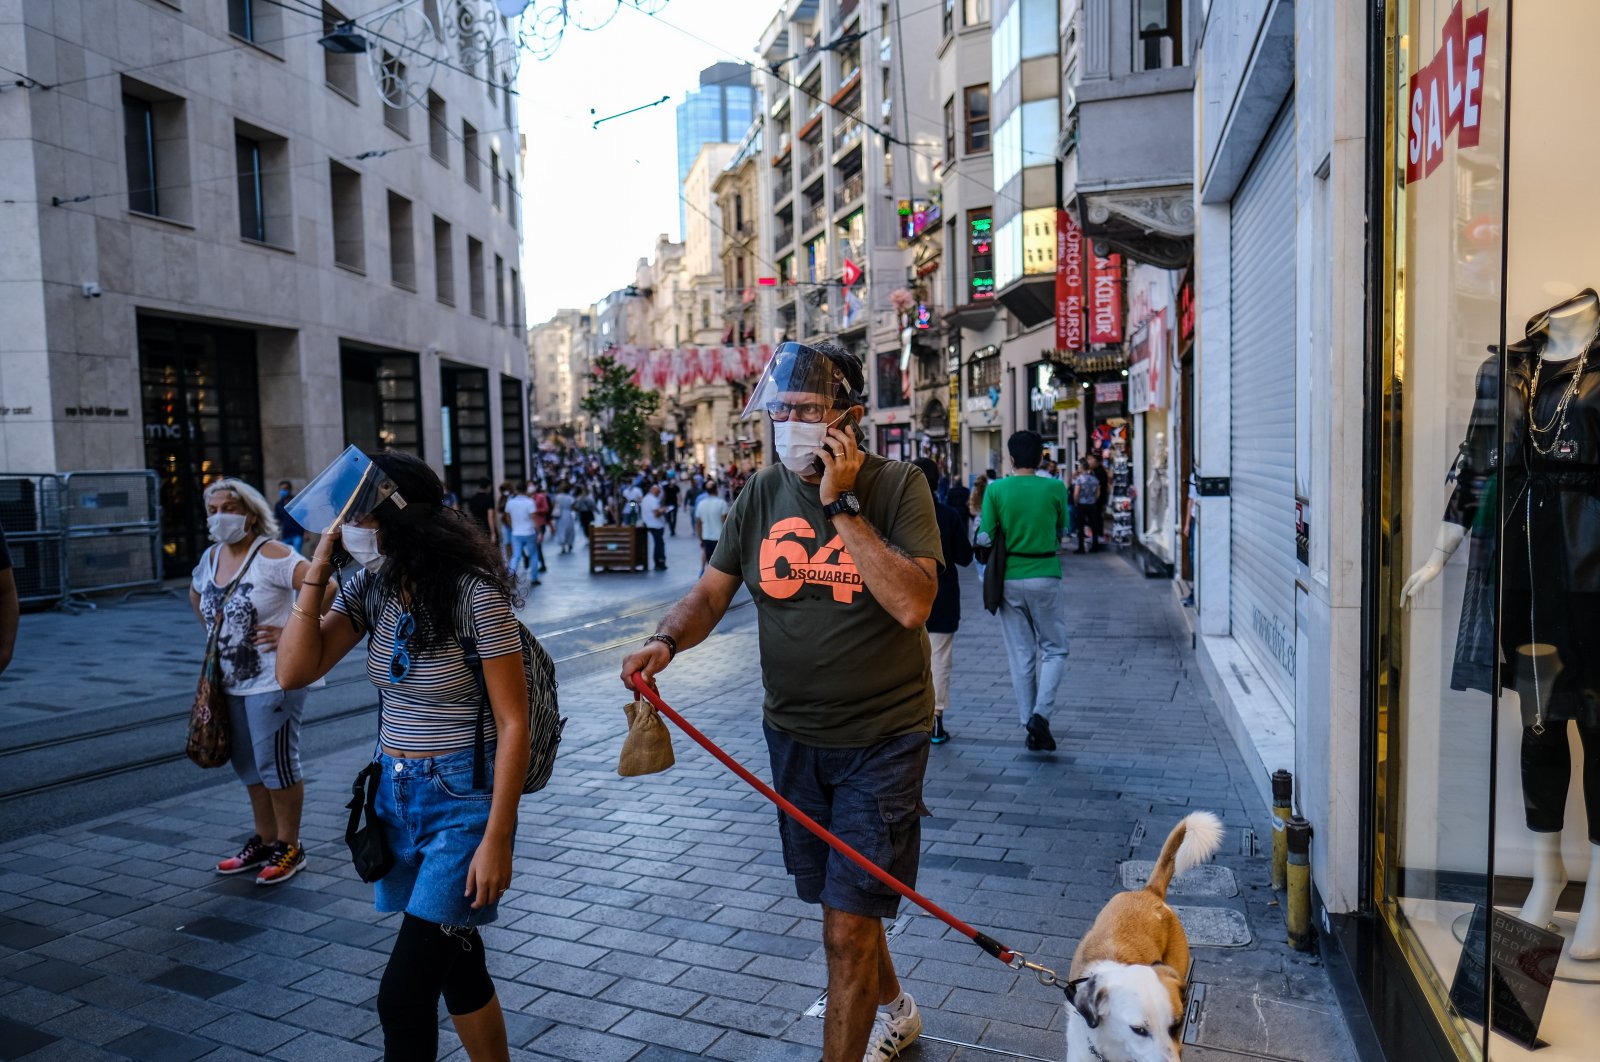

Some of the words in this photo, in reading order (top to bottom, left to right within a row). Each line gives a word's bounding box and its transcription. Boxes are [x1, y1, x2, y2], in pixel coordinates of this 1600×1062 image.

[1410, 35, 1483, 164] SALE
[1066, 295, 1080, 349] KURSU
[759, 517, 864, 604] 64
[788, 568, 864, 586] DSQUARED
